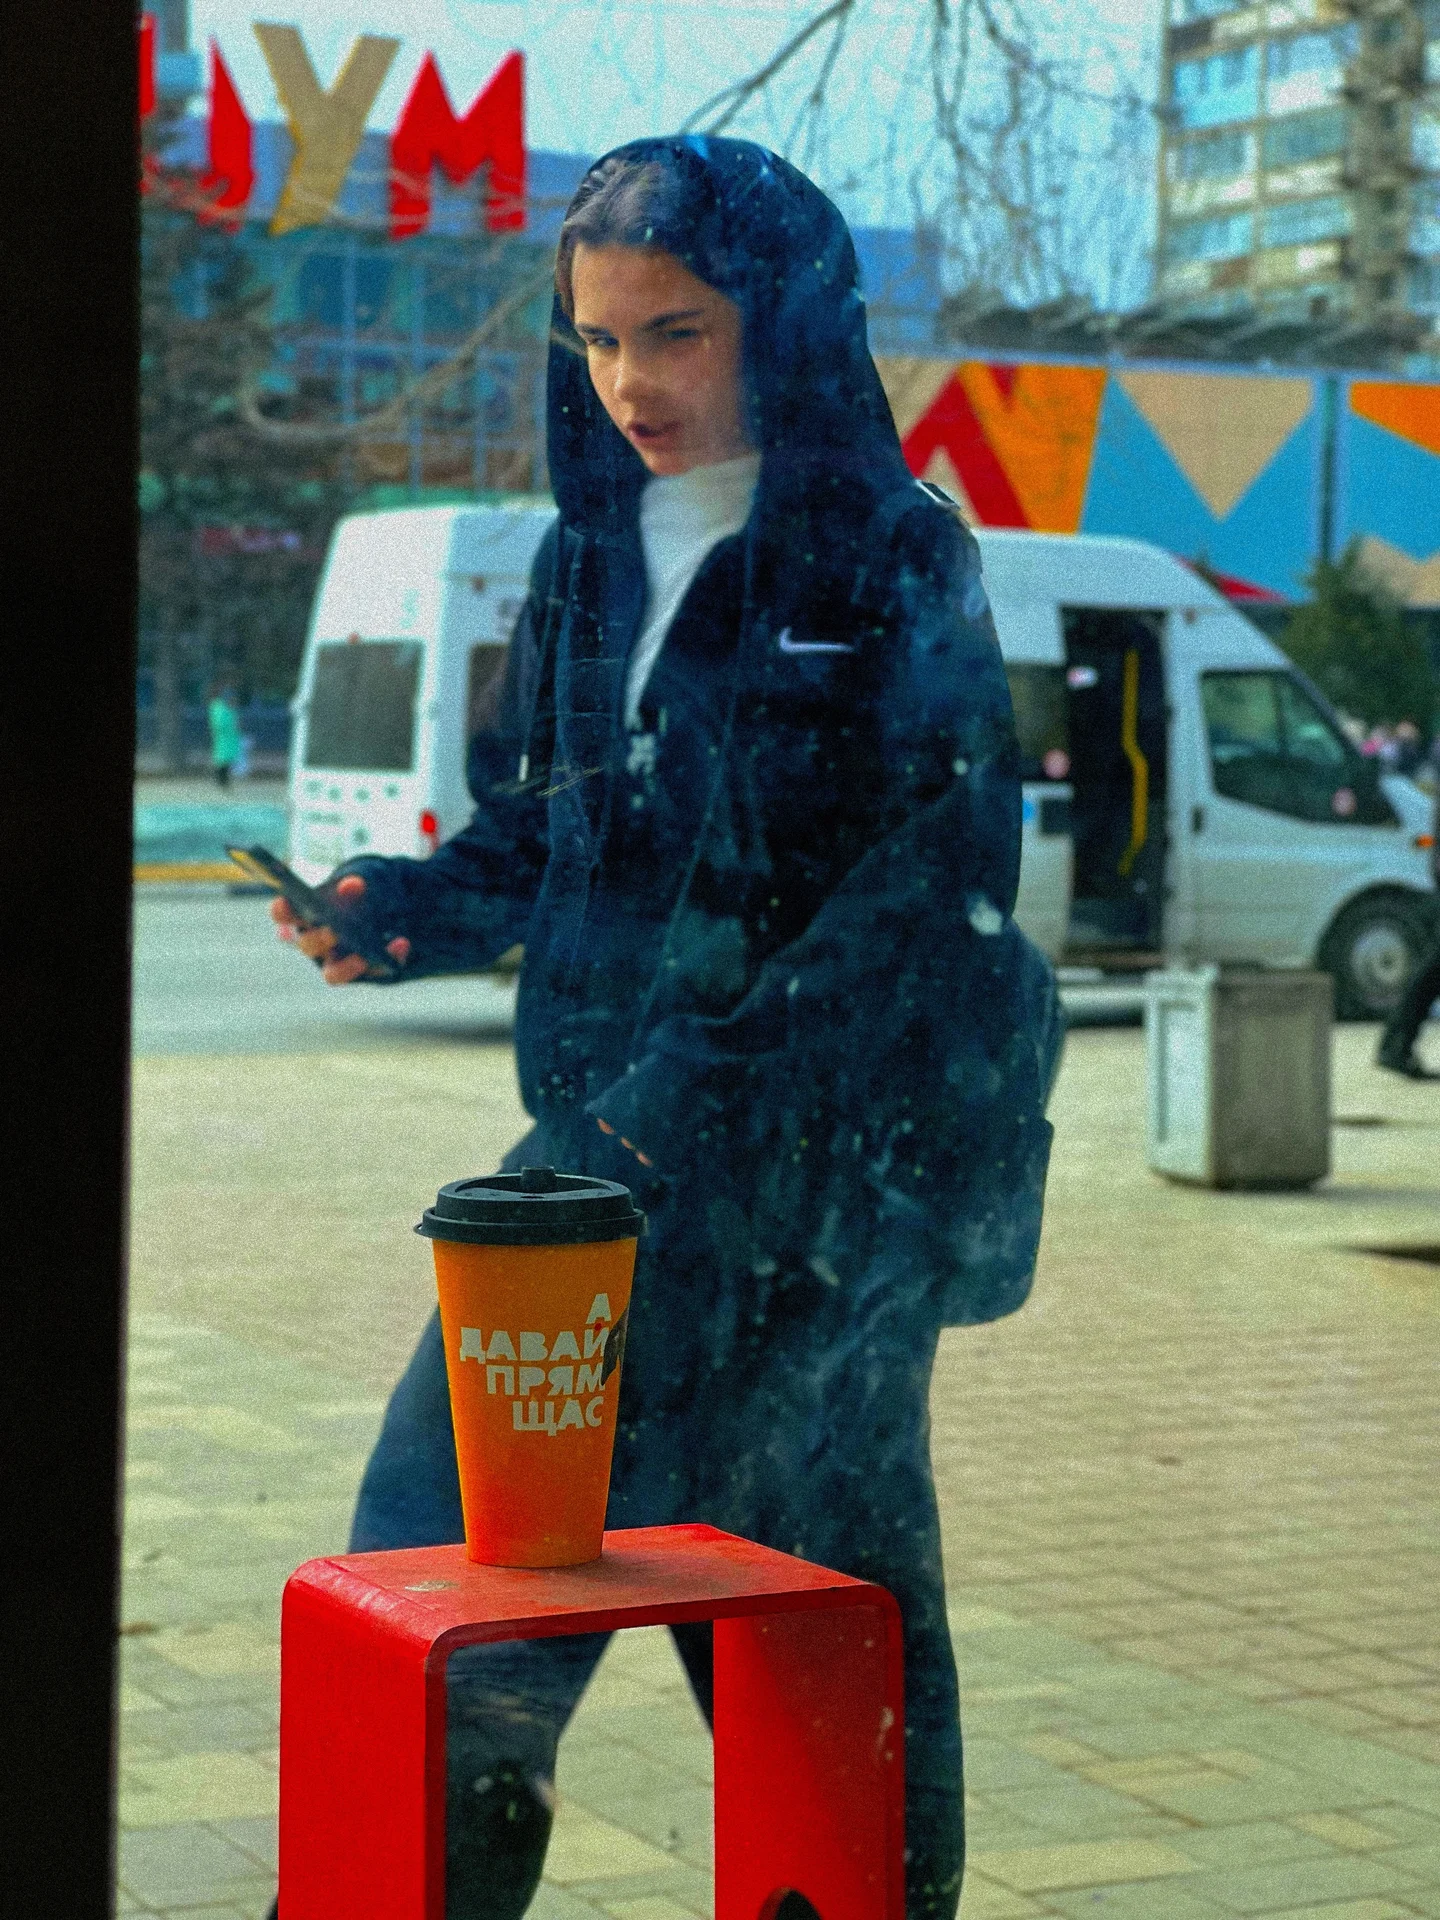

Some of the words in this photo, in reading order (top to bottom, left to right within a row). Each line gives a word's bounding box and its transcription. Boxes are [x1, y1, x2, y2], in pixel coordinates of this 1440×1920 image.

[586, 1292, 612, 1325] А
[459, 1325, 610, 1365] ДАВАЙ
[486, 1362, 606, 1396] ПРЯМ
[512, 1395, 604, 1437] ЩАС
